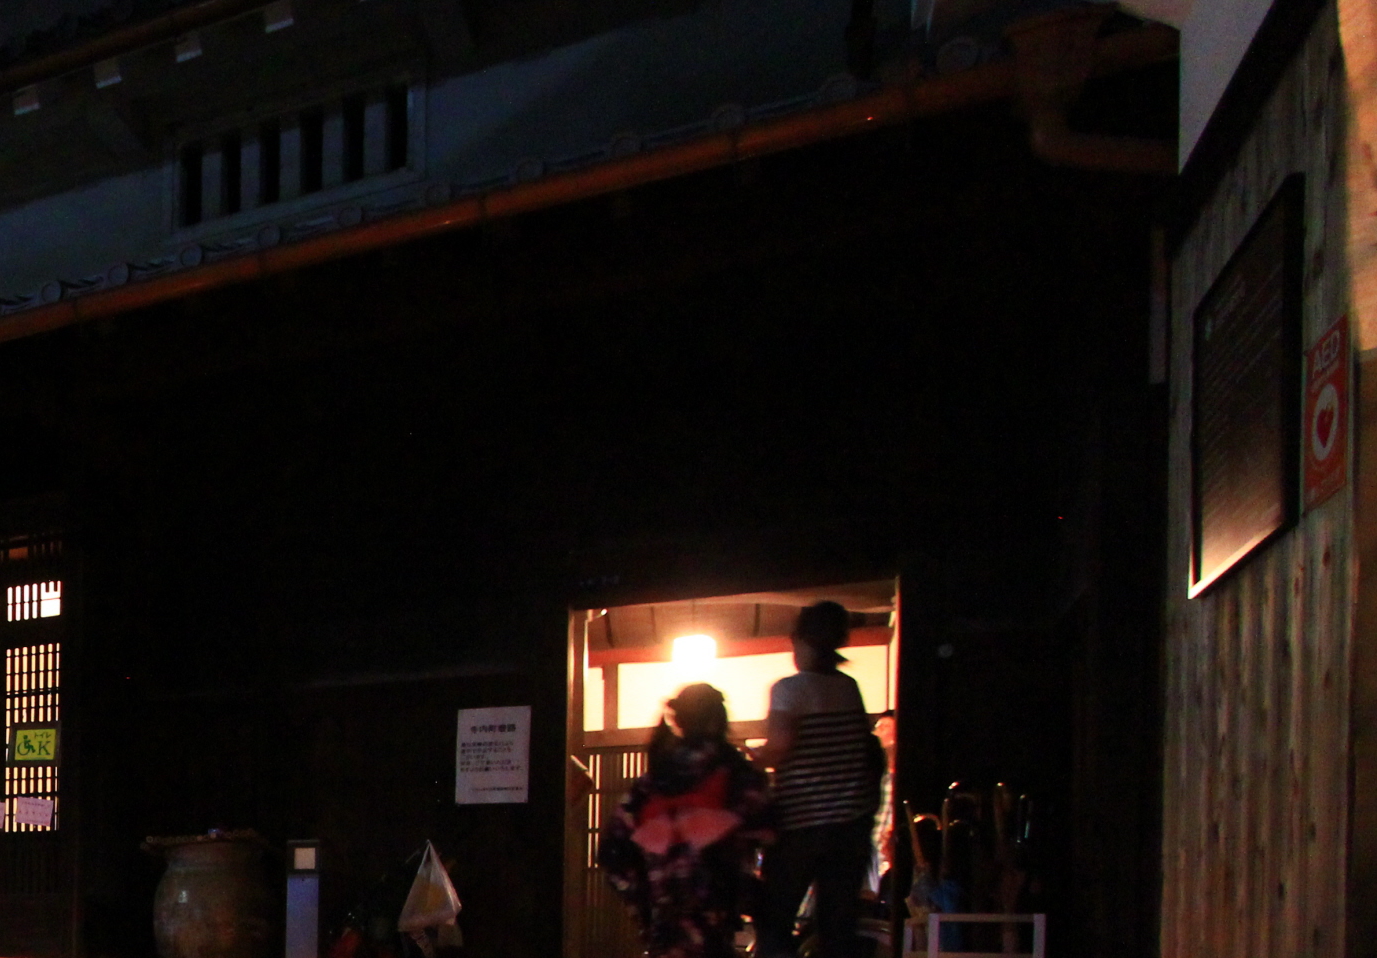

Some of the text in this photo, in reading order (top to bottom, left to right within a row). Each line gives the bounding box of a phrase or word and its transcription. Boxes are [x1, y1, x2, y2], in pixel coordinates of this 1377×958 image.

[1312, 329, 1341, 380] AED
[34, 731, 52, 739] トイレ
